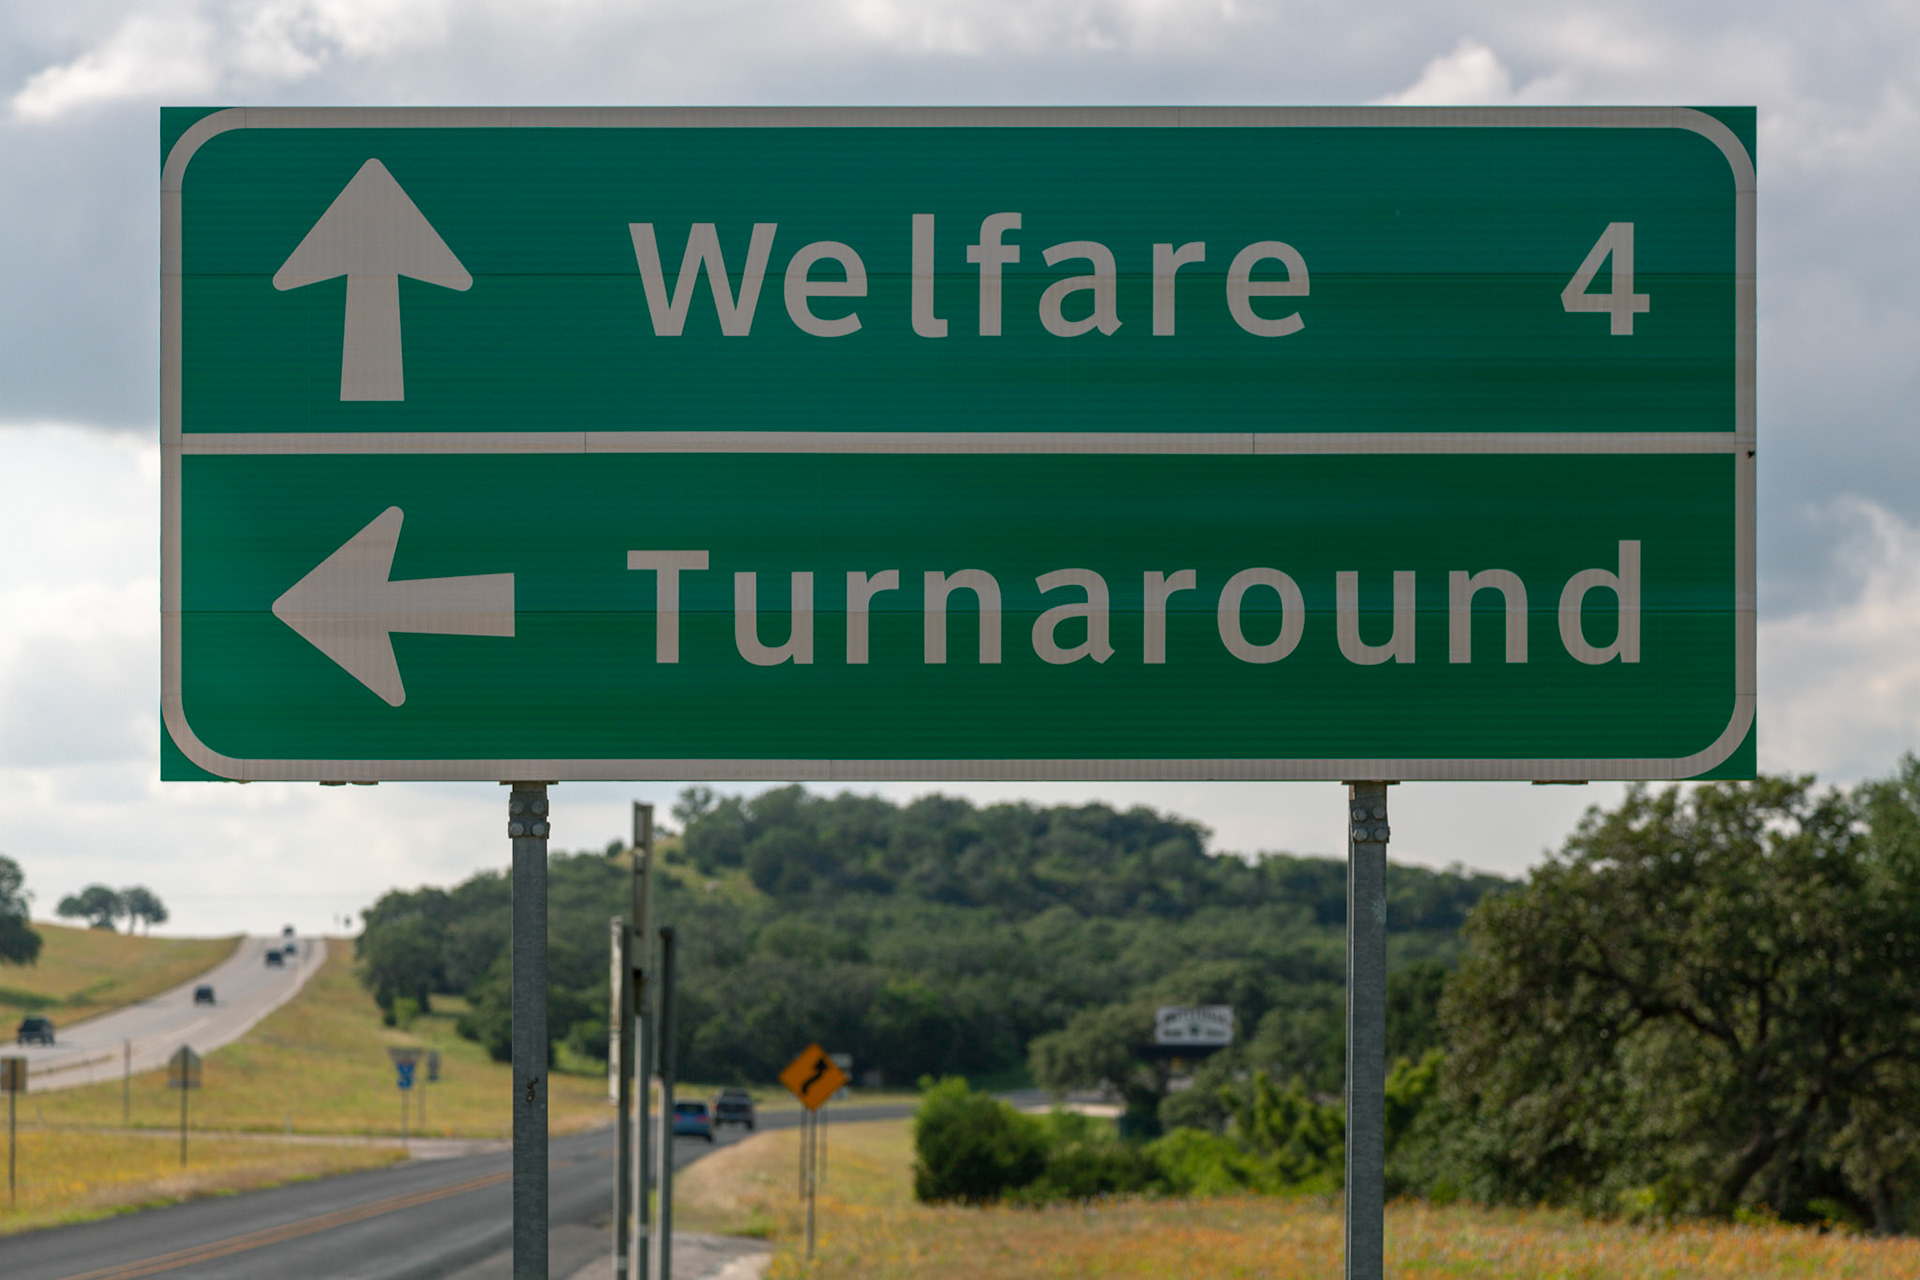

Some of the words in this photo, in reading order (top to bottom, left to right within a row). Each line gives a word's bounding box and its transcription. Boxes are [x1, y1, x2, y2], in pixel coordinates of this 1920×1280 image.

[629, 213, 1310, 338] Welfare
[1561, 223, 1650, 336] 4
[627, 540, 1641, 666] Turnaround
